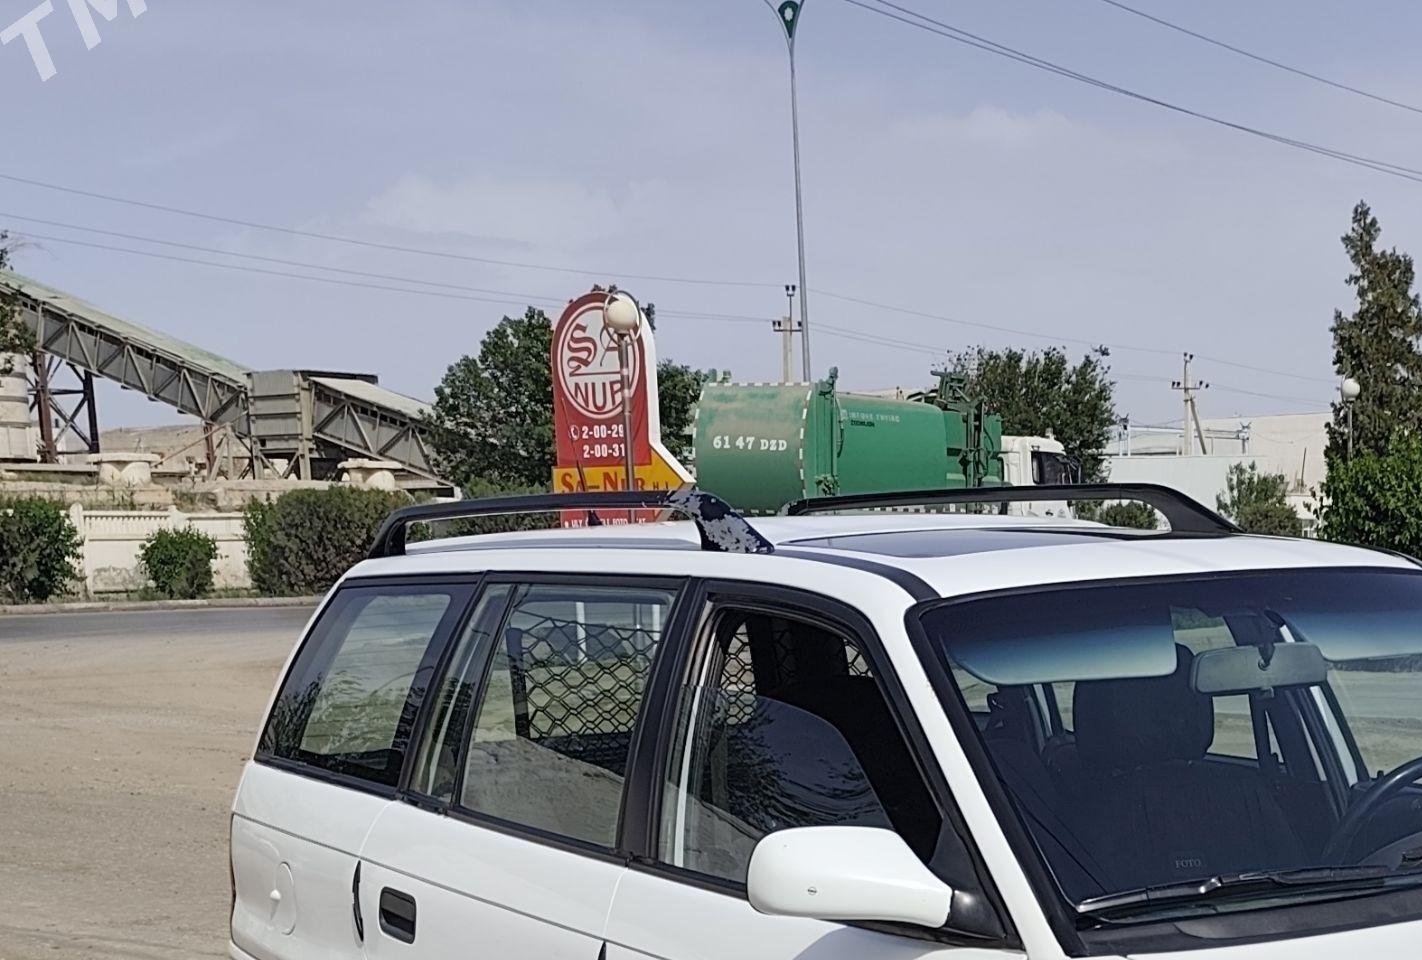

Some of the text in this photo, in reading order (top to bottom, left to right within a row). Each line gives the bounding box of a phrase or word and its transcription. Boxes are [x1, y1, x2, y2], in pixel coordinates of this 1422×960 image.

[583, 443, 626, 459] 2-00-31
[713, 435, 787, 451] 61 47 DZD
